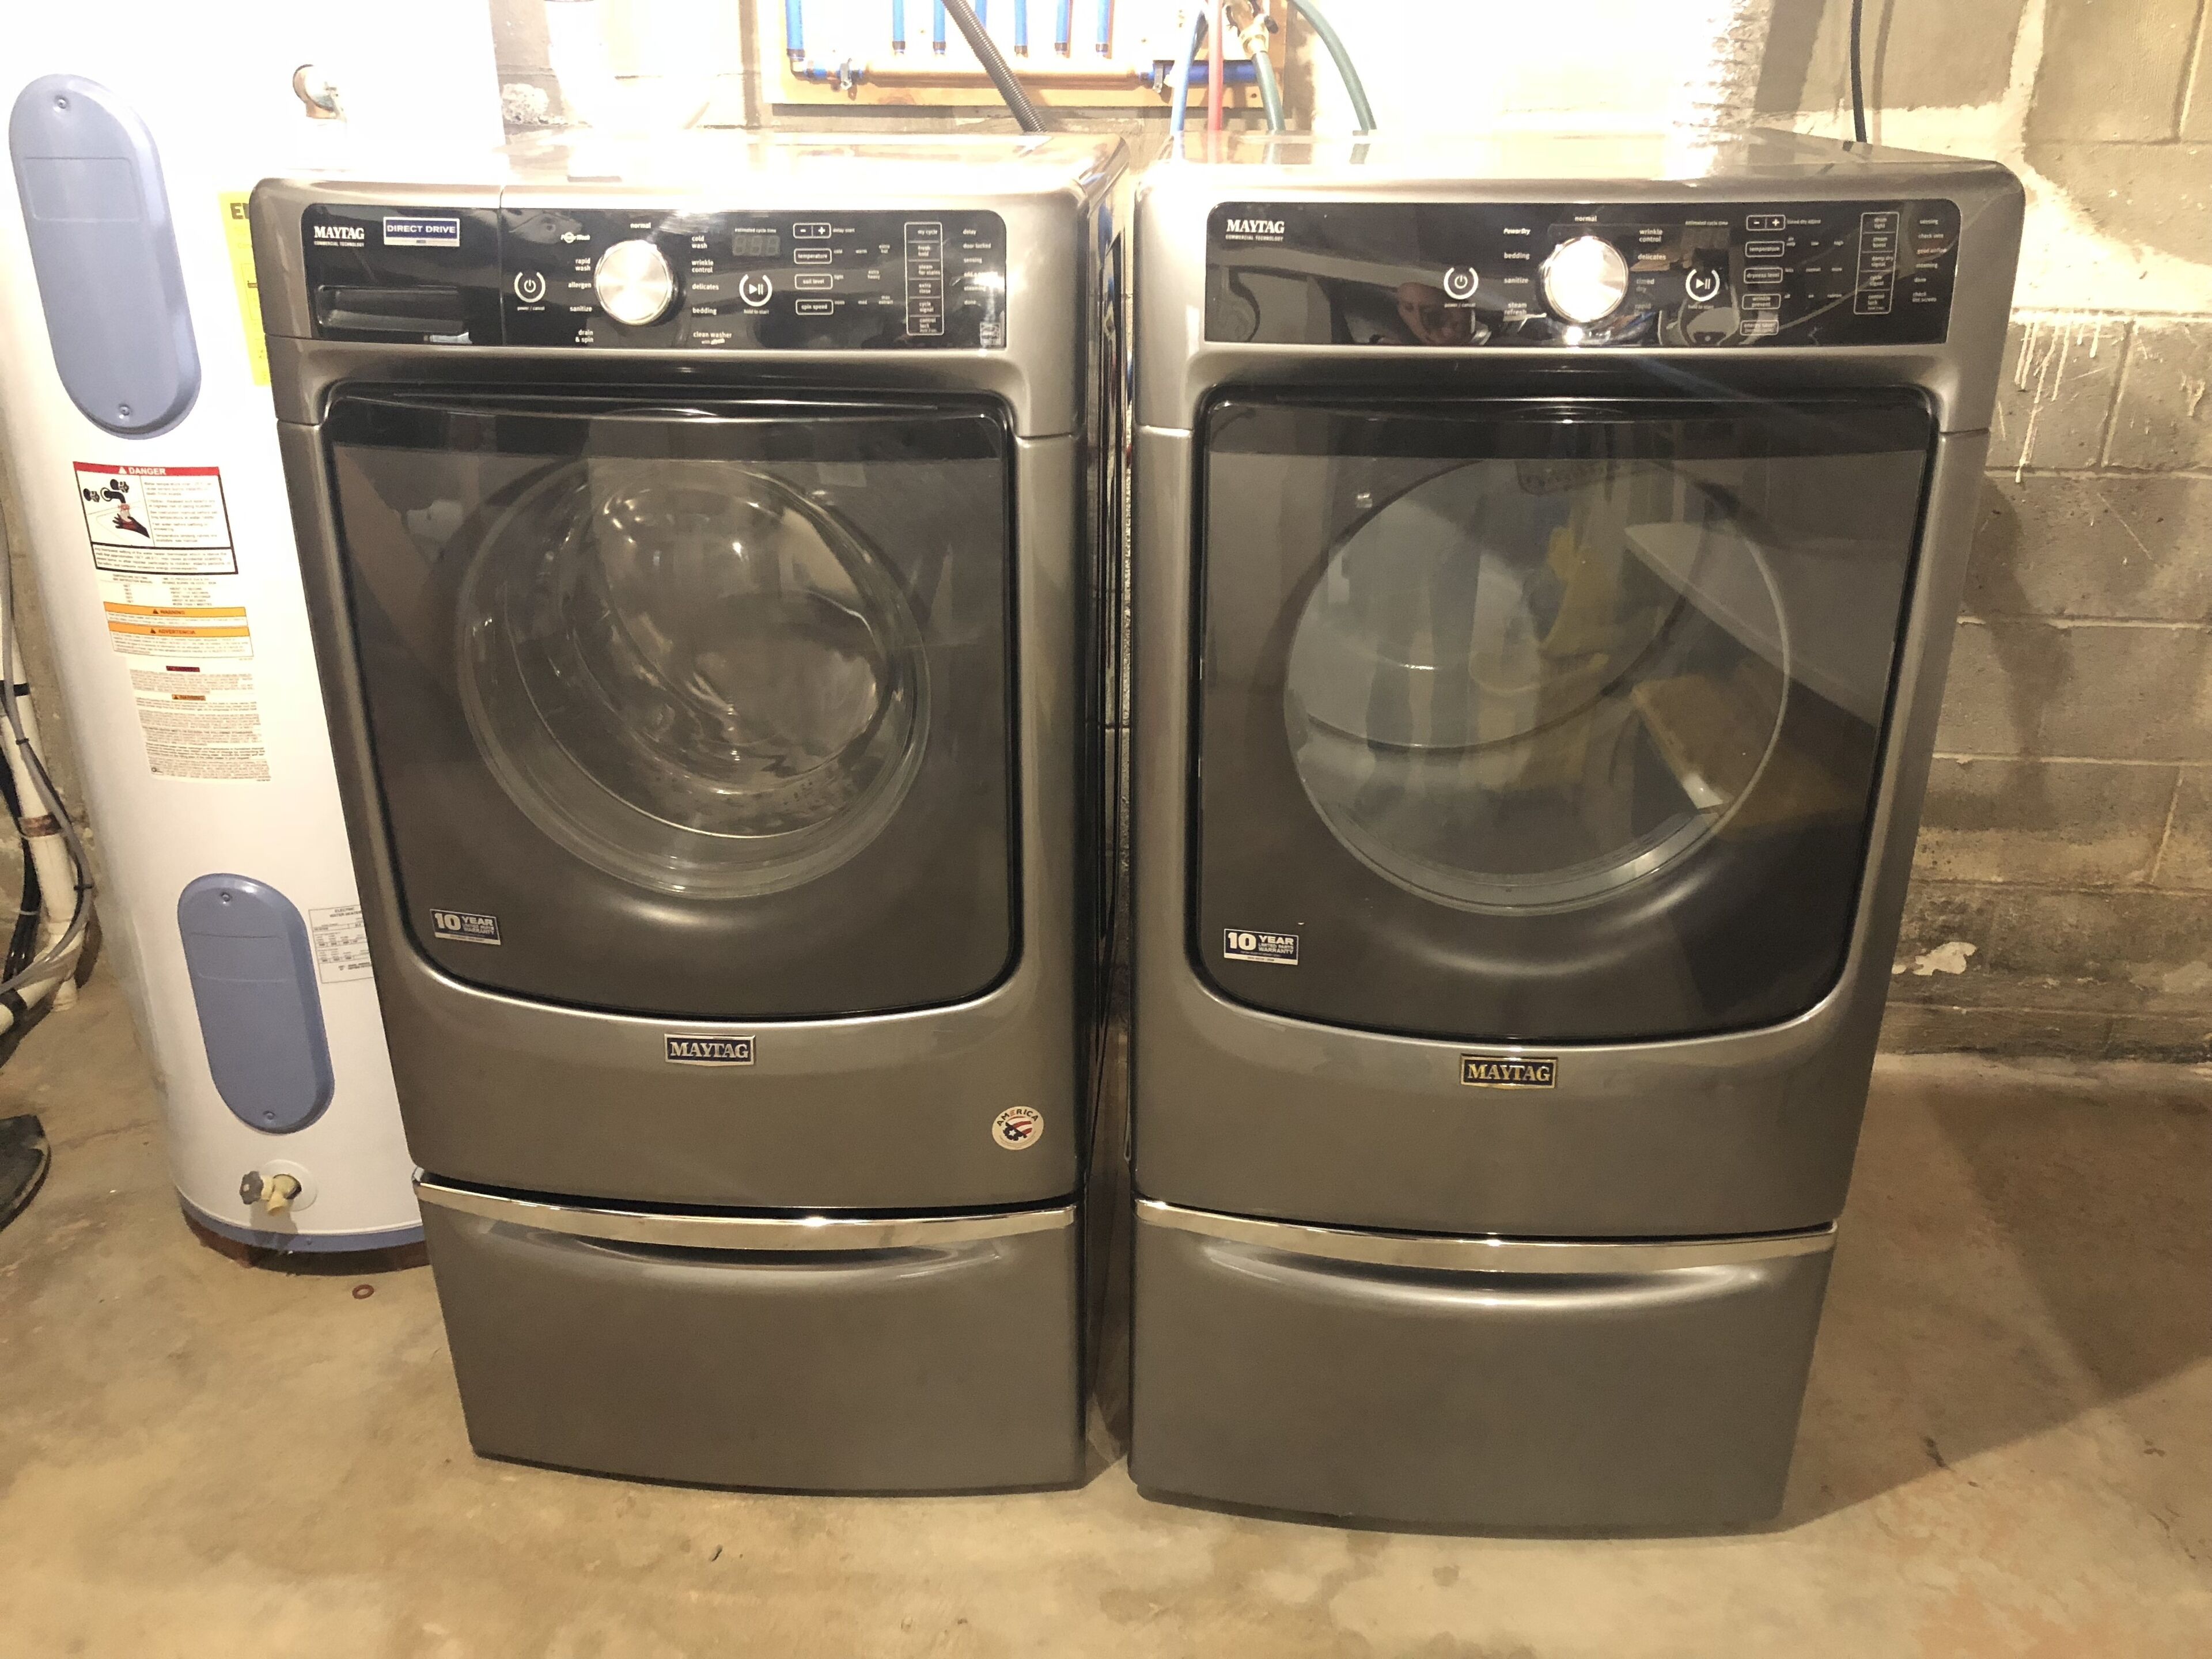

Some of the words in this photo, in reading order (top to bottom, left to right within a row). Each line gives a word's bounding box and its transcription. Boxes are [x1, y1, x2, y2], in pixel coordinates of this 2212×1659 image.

[314, 226, 365, 240] MAYTAG
[387, 225, 423, 233] DIRECT
[425, 225, 456, 234] DRIVE
[1226, 219, 1285, 233] MAYTAG
[692, 307, 717, 316] bedding
[128, 467, 166, 475] DANGER
[434, 913, 461, 931] 10
[461, 916, 494, 926] YEAR
[1228, 932, 1256, 950] 10
[1259, 935, 1294, 945] YEAR
[670, 1041, 749, 1058] MAYTAG
[1468, 1063, 1551, 1081] MAYTAG
[997, 1109, 1038, 1127] AMERICA
